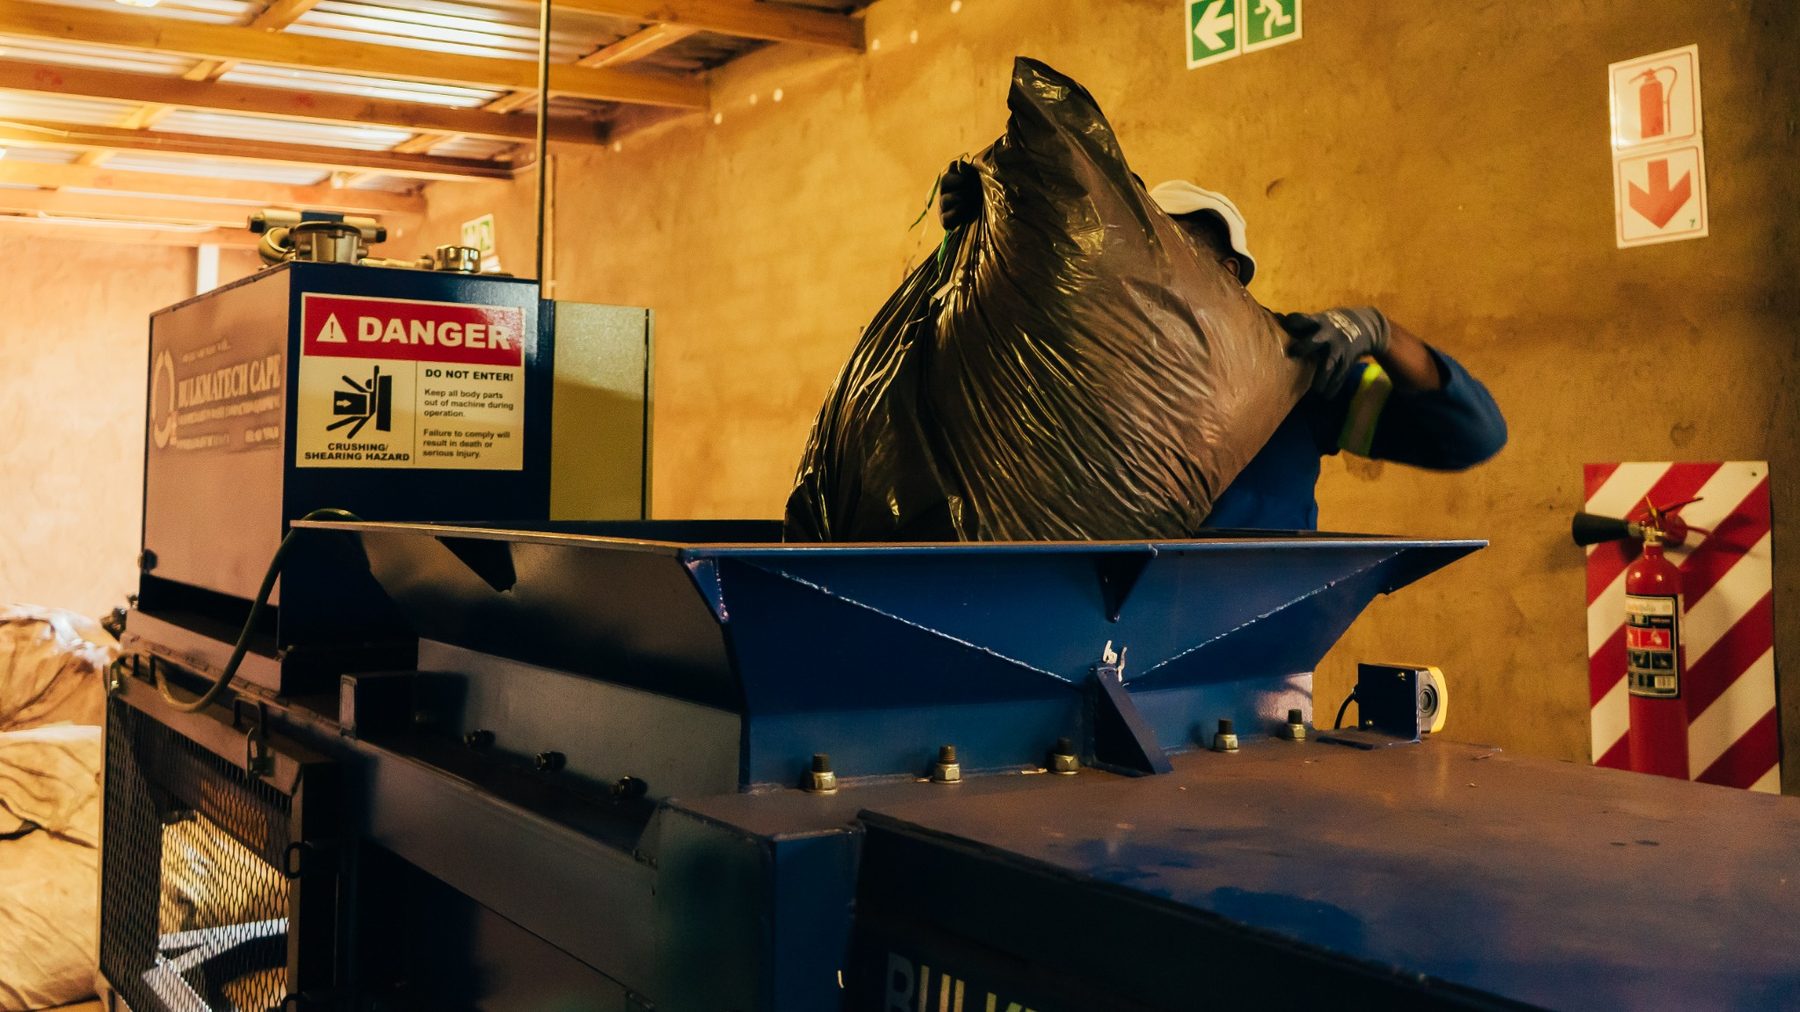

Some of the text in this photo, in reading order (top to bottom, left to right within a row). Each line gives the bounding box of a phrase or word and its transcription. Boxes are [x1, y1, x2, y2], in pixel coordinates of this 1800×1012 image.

[358, 316, 511, 350] DANGER
[250, 354, 281, 392] CAPE
[425, 368, 514, 381] DO NOT ENTER!
[424, 389, 446, 397] Keep
[460, 390, 481, 399] body
[487, 401, 514, 410] during
[423, 428, 452, 437] Failure
[465, 431, 494, 439] comply
[328, 442, 388, 452] CRUSHING/
[304, 452, 410, 461] SHEARING HAZARD
[456, 450, 480, 459] injury.
